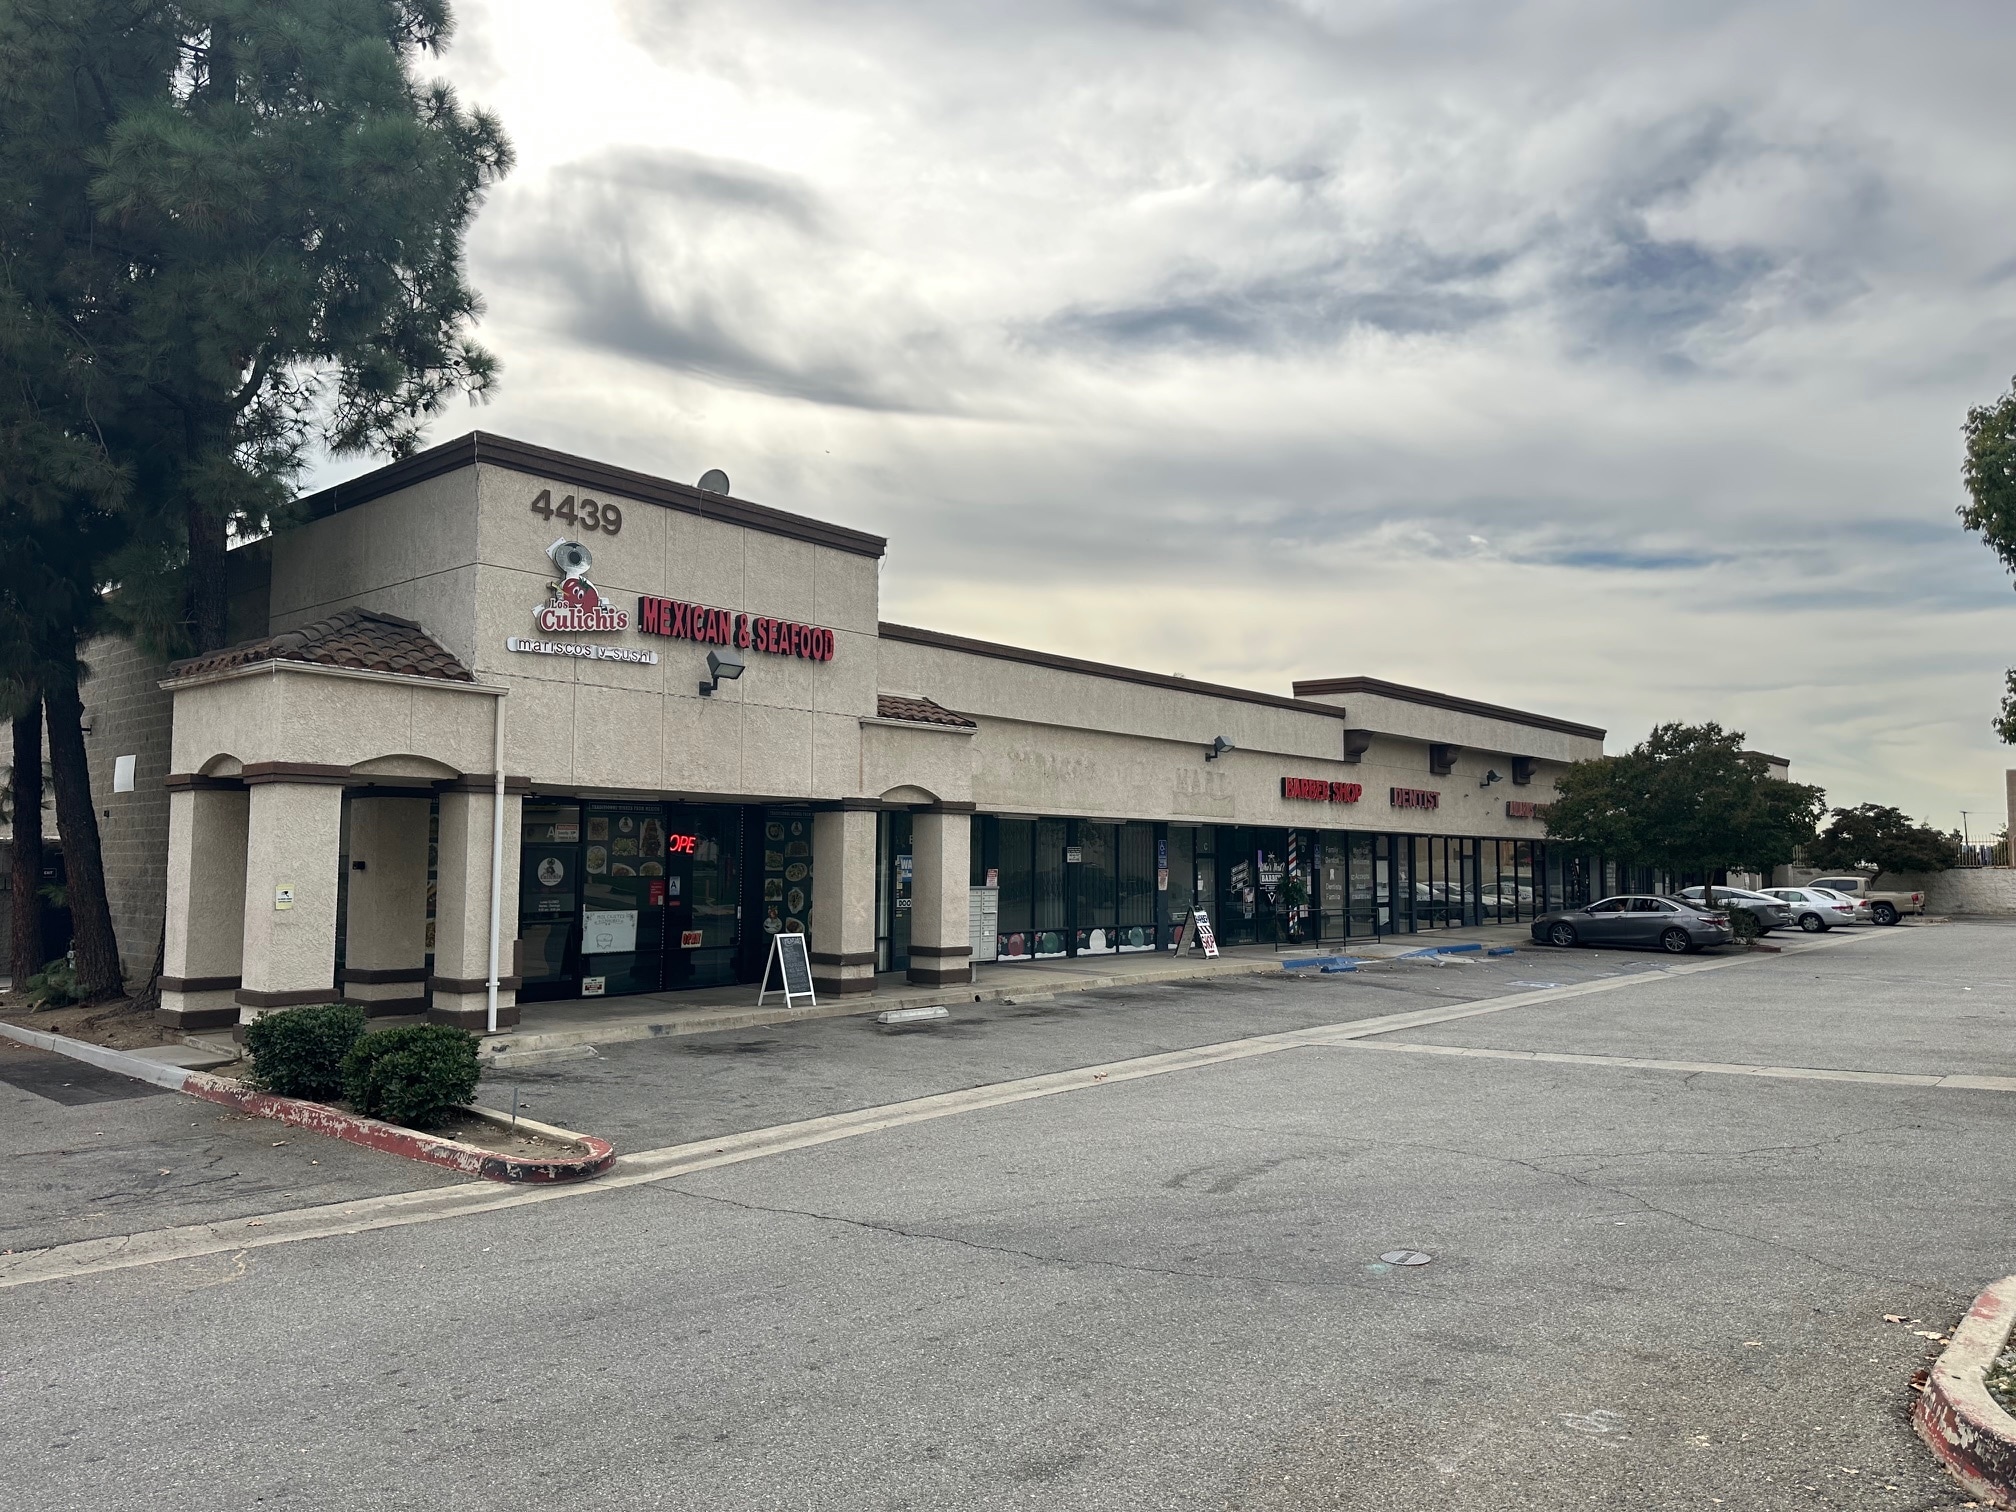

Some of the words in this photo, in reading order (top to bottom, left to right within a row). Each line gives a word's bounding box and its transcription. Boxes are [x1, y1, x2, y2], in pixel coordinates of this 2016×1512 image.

[531, 489, 623, 536] 4439
[541, 607, 628, 631] Culichis
[639, 596, 731, 646] MEXICAN
[734, 613, 750, 649] &
[752, 616, 835, 662] SEAFOOD
[518, 638, 592, 656] mariscos
[599, 648, 607, 658] y
[613, 648, 651, 663] sushi
[1281, 777, 1329, 801] BARBER
[1329, 782, 1363, 803] SHOP
[1390, 787, 1441, 809] DENTIST
[671, 880, 677, 889] A
